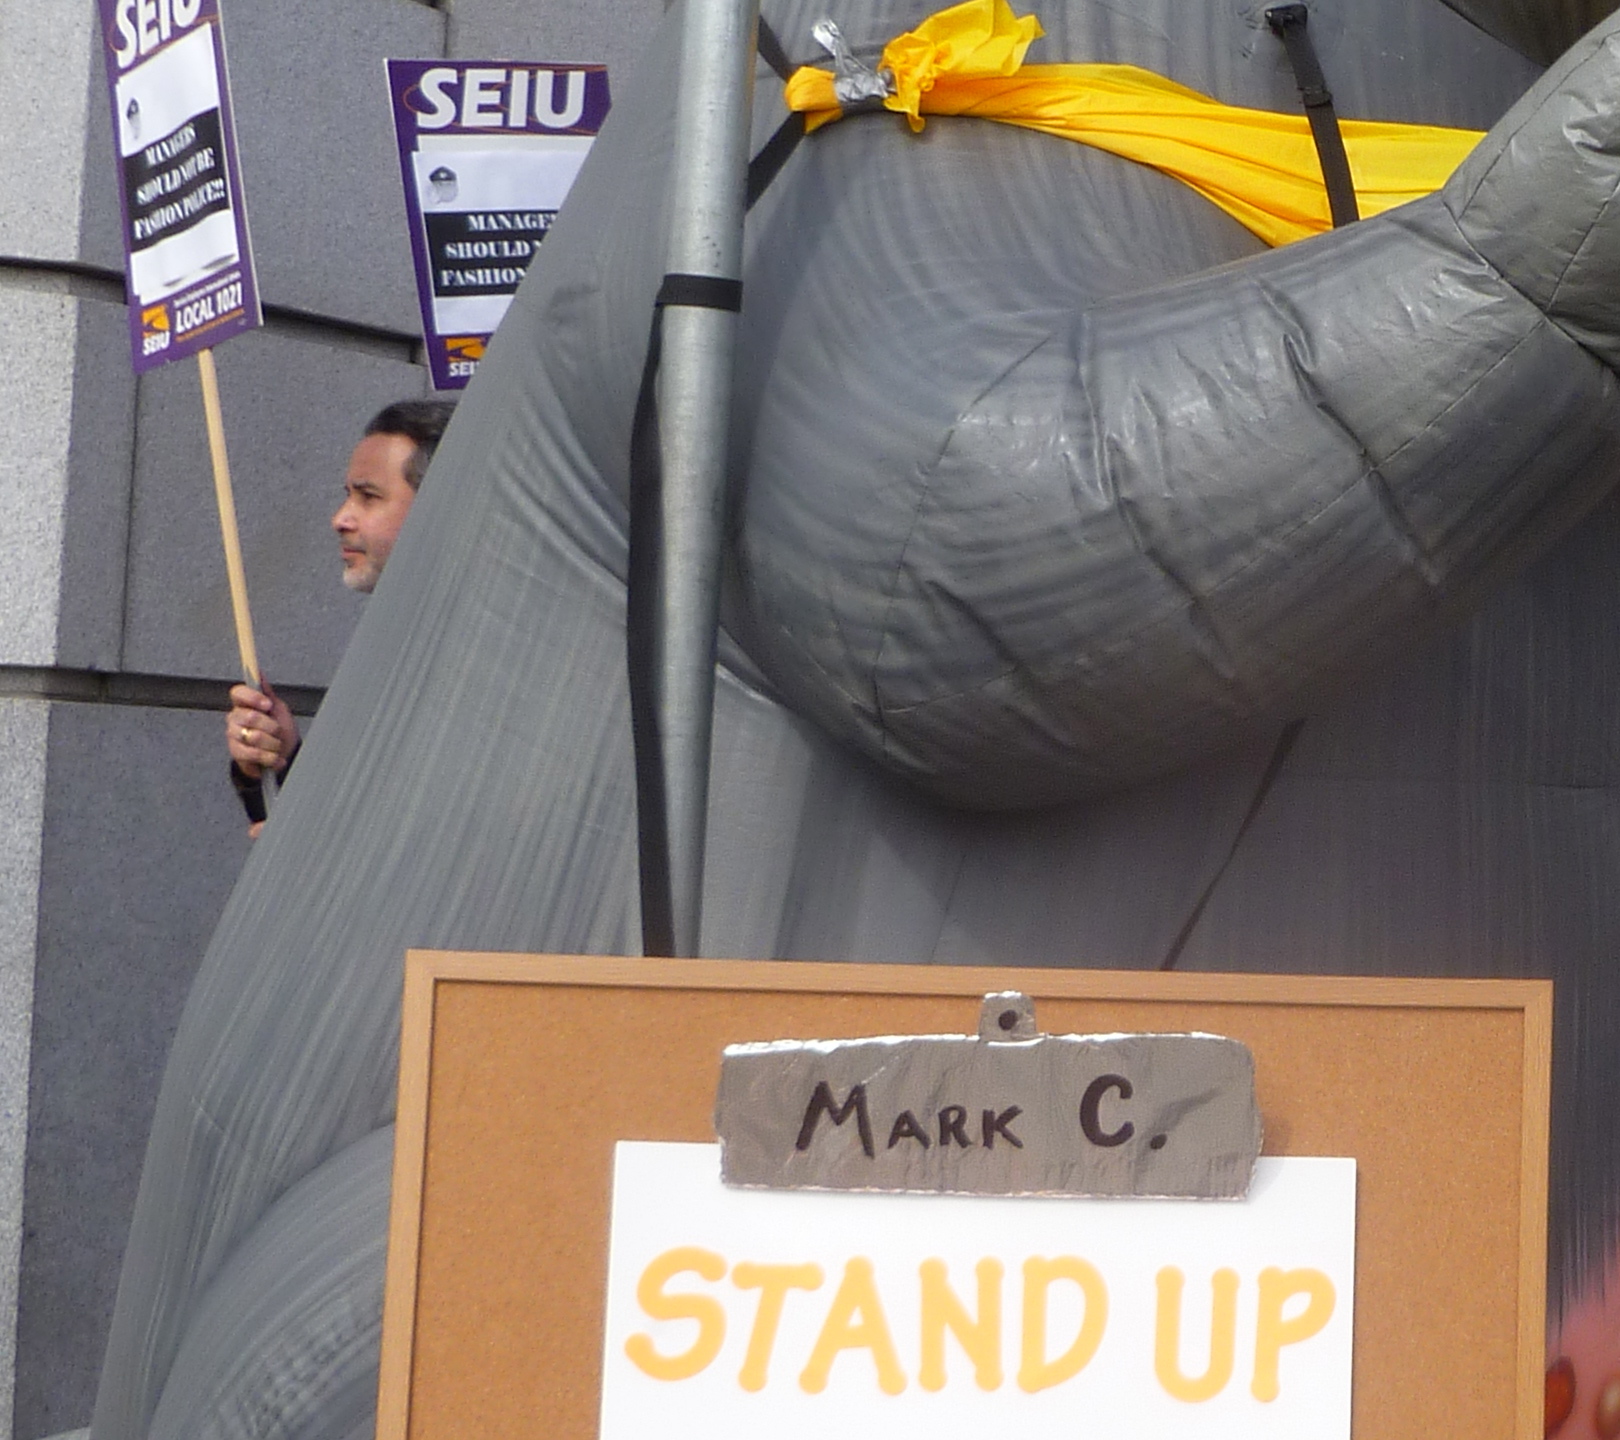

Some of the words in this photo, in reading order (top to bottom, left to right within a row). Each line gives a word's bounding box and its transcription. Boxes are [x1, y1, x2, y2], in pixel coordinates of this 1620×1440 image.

[417, 68, 586, 129] SEIU
[445, 240, 531, 259] SHOULD
[176, 296, 216, 334] LOCAL
[216, 281, 243, 315] 1021
[143, 331, 171, 356] SEIU
[449, 361, 480, 378] SEI
[1076, 1073, 1174, 1153] C.
[625, 1248, 1106, 1394] STAND
[1155, 1266, 1336, 1402] UP
